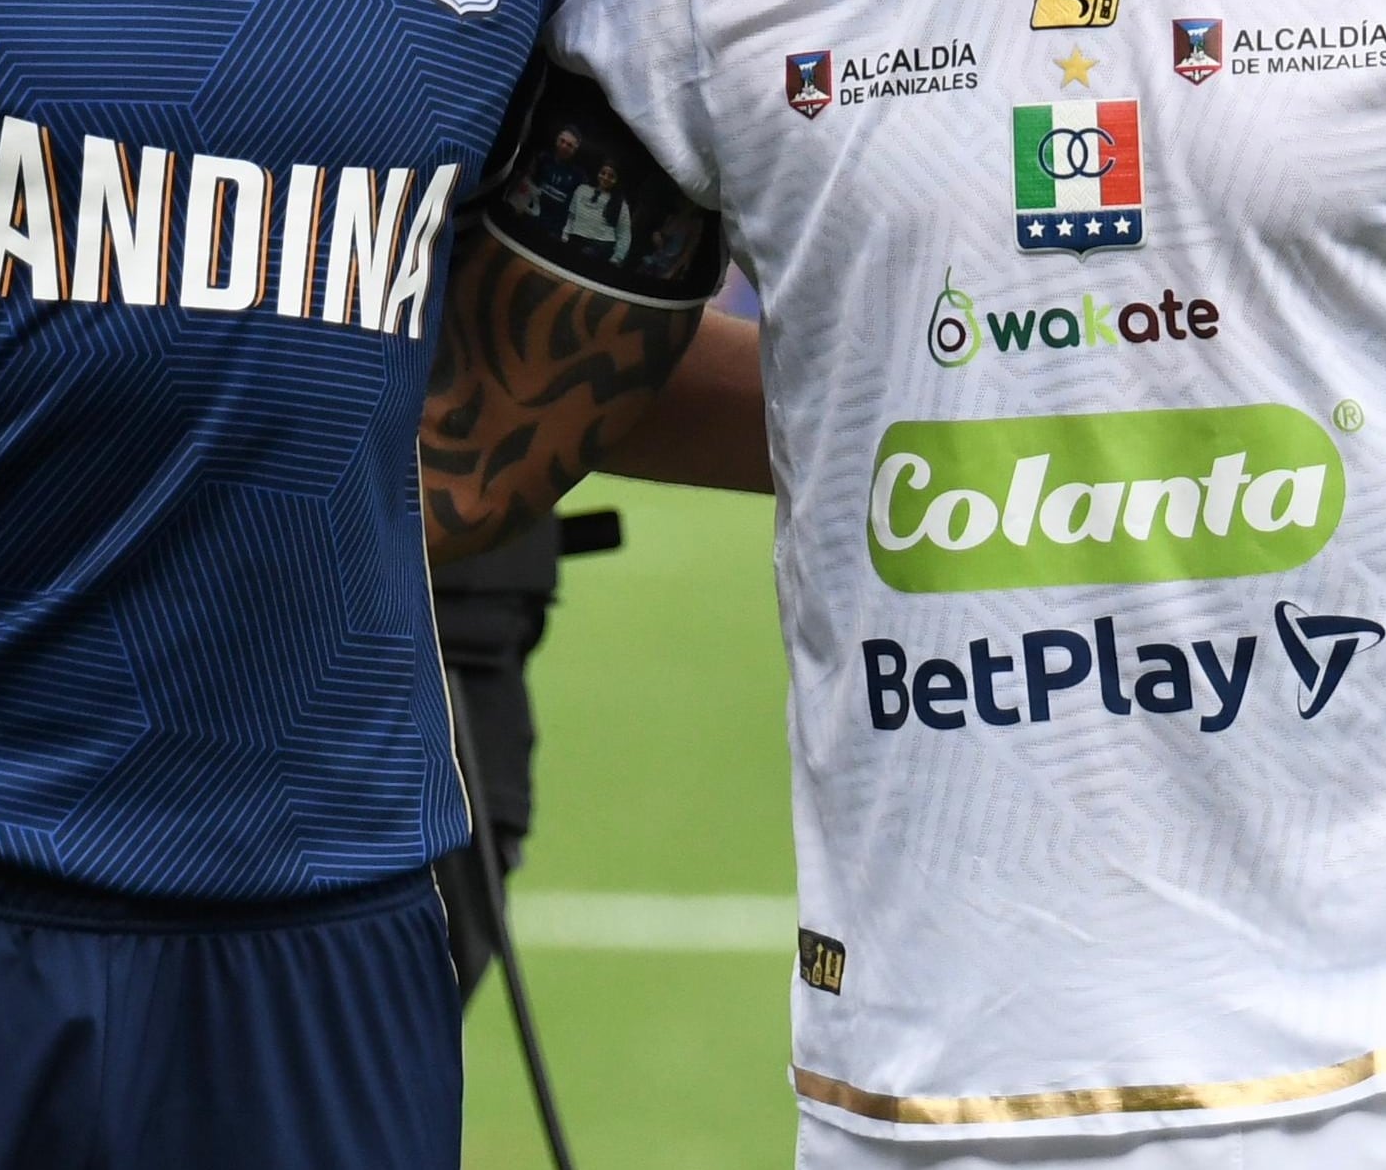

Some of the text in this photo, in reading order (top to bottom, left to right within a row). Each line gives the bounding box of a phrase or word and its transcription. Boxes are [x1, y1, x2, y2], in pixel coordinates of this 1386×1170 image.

[839, 39, 977, 84] ALCALDÍA
[1231, 58, 1261, 76] DE
[839, 72, 978, 107] DE MANIZALES
[986, 289, 1220, 352] wakate
[870, 451, 1327, 552] Colanta
[862, 616, 1258, 734] BetPlay
